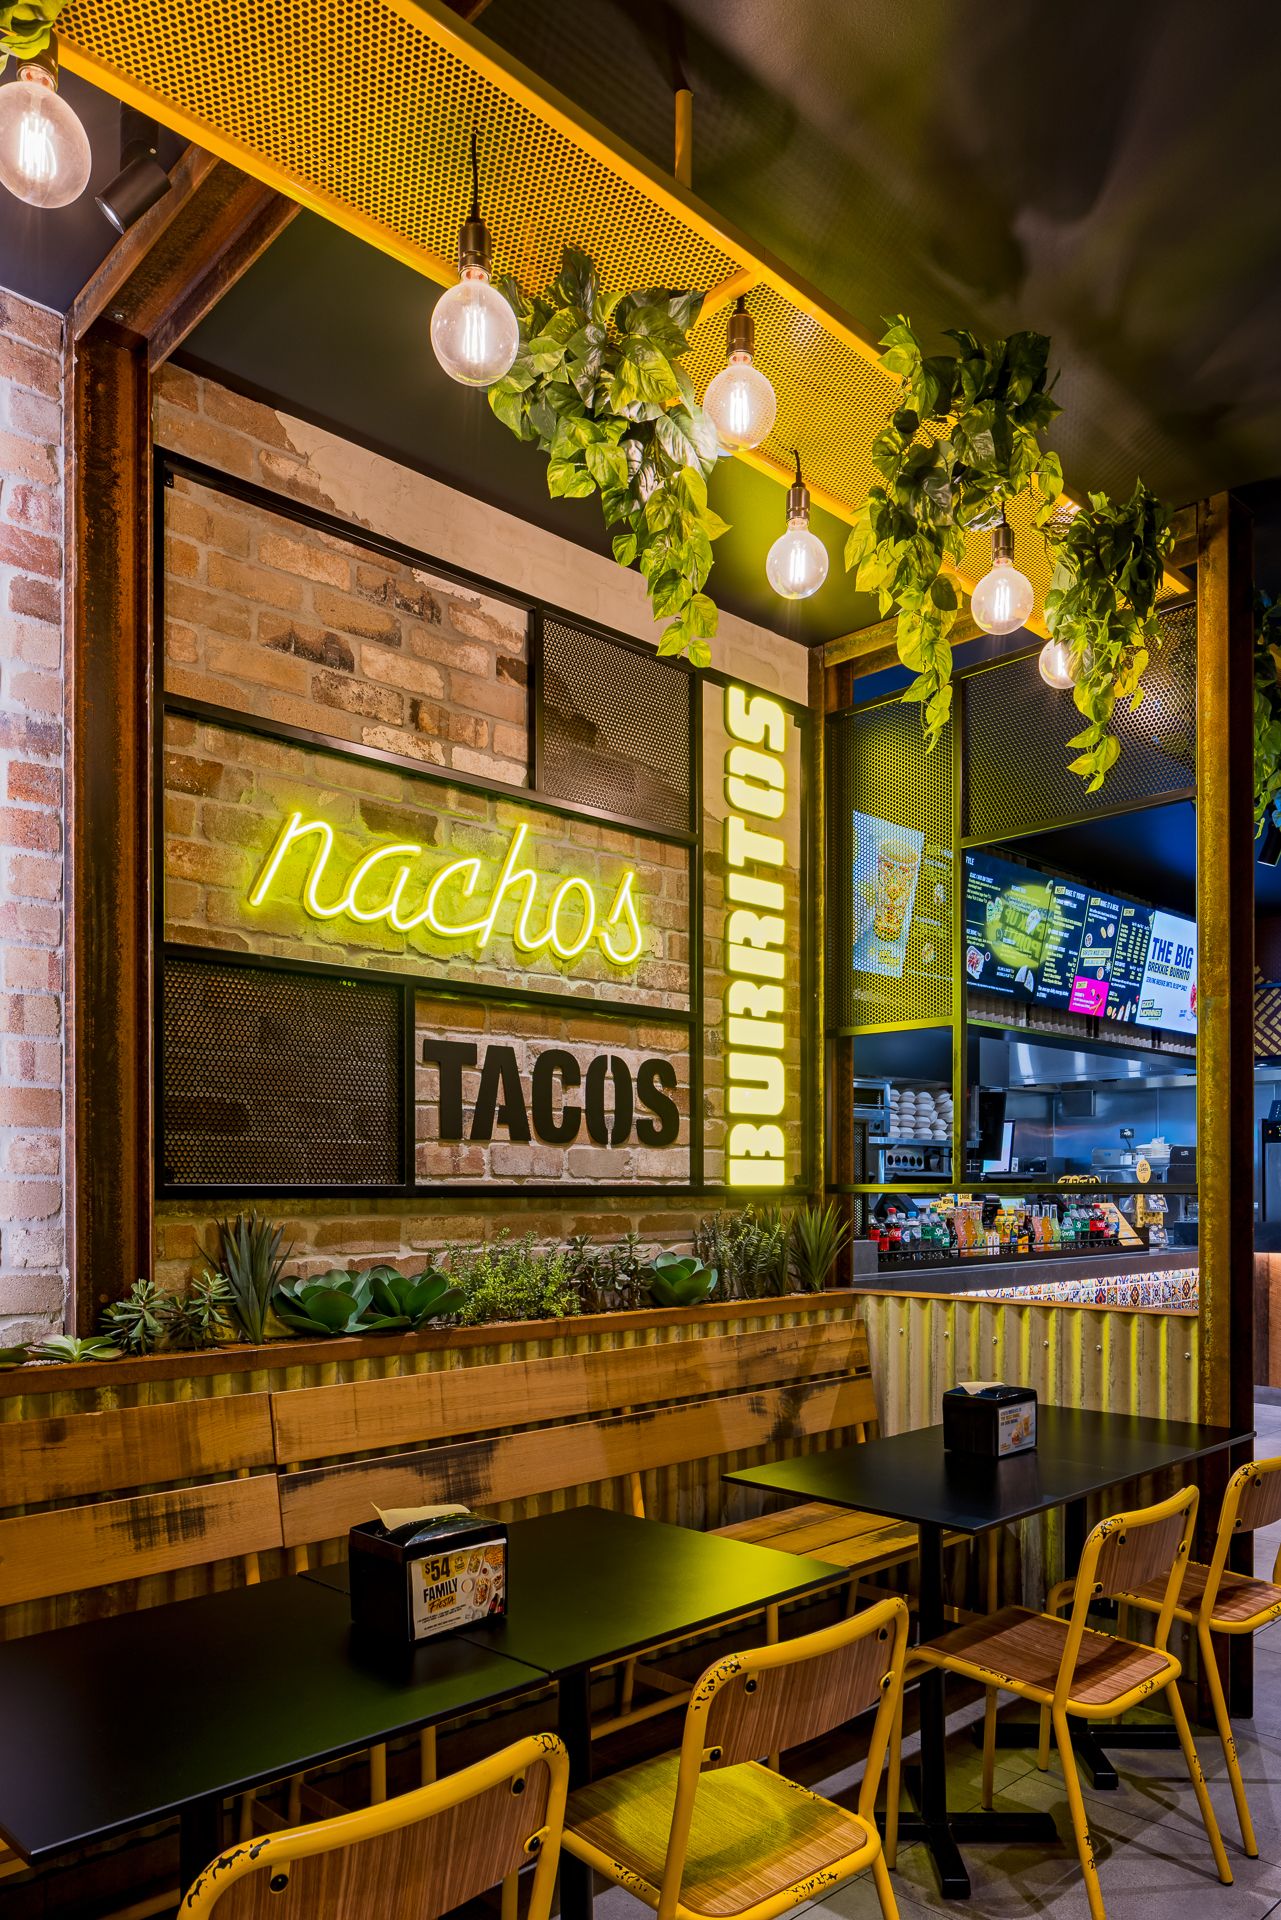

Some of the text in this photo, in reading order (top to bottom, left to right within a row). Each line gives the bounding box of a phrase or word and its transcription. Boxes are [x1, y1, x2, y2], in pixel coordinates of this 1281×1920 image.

[248, 811, 644, 964] nachos
[725, 683, 787, 1187] BURRITOS
[1152, 937, 1174, 964] THE
[1174, 943, 1194, 970] BIG
[1147, 961, 1169, 976] BREKKIE
[1169, 966, 1191, 981] BURRITO
[423, 1039, 680, 1147] TACOS
[424, 1557, 451, 1582] $54
[423, 1578, 458, 1603] FAMILY
